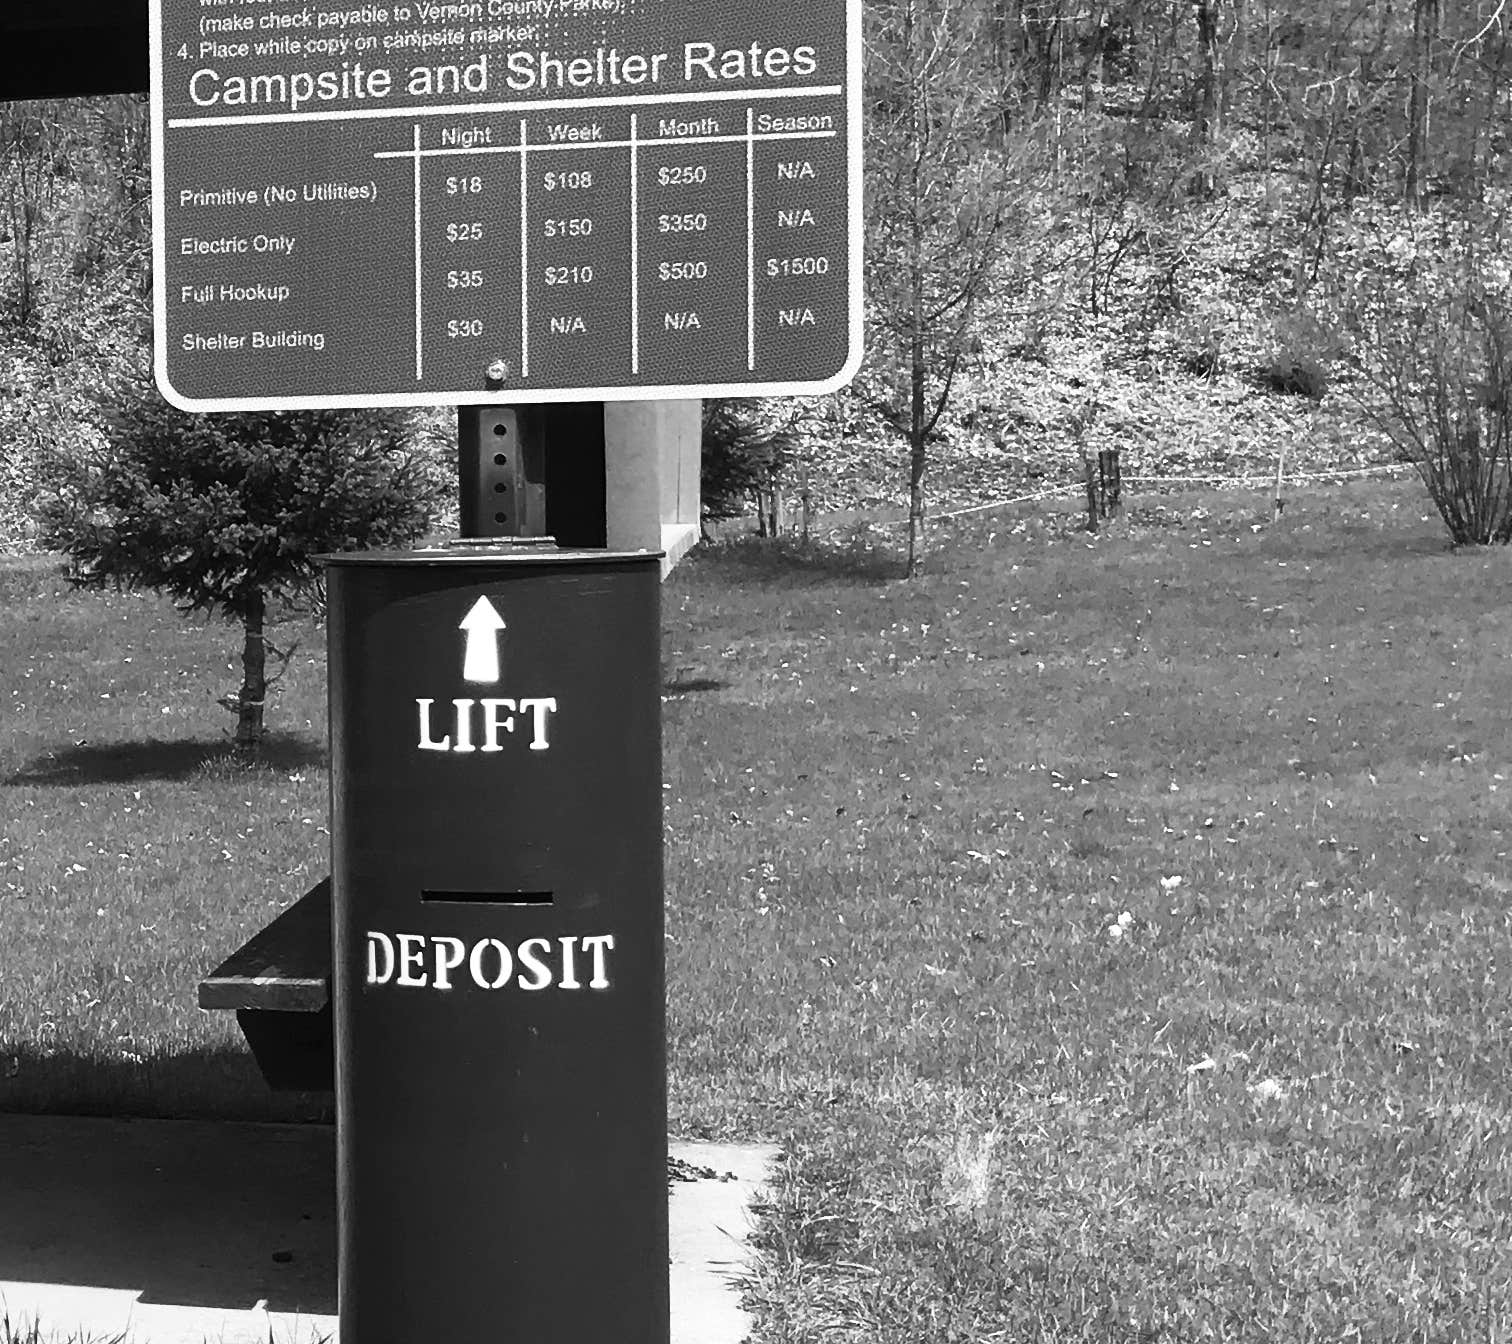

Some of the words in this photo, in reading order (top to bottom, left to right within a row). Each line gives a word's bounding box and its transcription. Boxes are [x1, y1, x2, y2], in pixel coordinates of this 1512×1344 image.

[199, 14, 254, 36] (make
[259, 8, 311, 29] check
[317, 6, 388, 29] payable
[393, 6, 411, 22] to
[415, 1, 483, 21] Vernon
[176, 43, 193, 60] 4.
[199, 39, 249, 59] Place
[305, 34, 350, 56] copy
[354, 35, 377, 51] on
[383, 27, 465, 51] campsite
[189, 63, 392, 112] Campsite
[407, 52, 488, 96] and
[505, 48, 667, 91] Shelter
[684, 40, 817, 82] Rates
[441, 126, 493, 148] Night
[547, 123, 603, 142] Week
[658, 117, 720, 137] Month
[757, 113, 834, 133] Season
[179, 188, 258, 207] Primitive
[263, 184, 297, 207] (No
[303, 180, 378, 203] Utilities)
[446, 176, 483, 195] $18
[543, 171, 593, 192] $108
[657, 165, 708, 186] $250
[777, 161, 816, 180] N/A
[180, 236, 248, 255] Electric
[253, 234, 296, 256] Only
[446, 222, 483, 243] $25
[543, 218, 593, 238] $150
[657, 212, 708, 233] $350
[777, 209, 816, 227] N/A
[180, 285, 213, 304] Full
[220, 283, 290, 303] Hookup
[447, 270, 484, 290] $35
[544, 266, 594, 286] $210
[658, 261, 708, 281] $500
[766, 256, 829, 277] $1500
[182, 331, 246, 351] Shelter
[252, 329, 326, 351] Building
[447, 319, 484, 339] $30
[549, 316, 588, 334] N/A
[663, 311, 702, 330] N/A
[778, 307, 816, 327] N/A
[415, 696, 558, 754] LIFT
[366, 929, 616, 992] DEPOSIT
